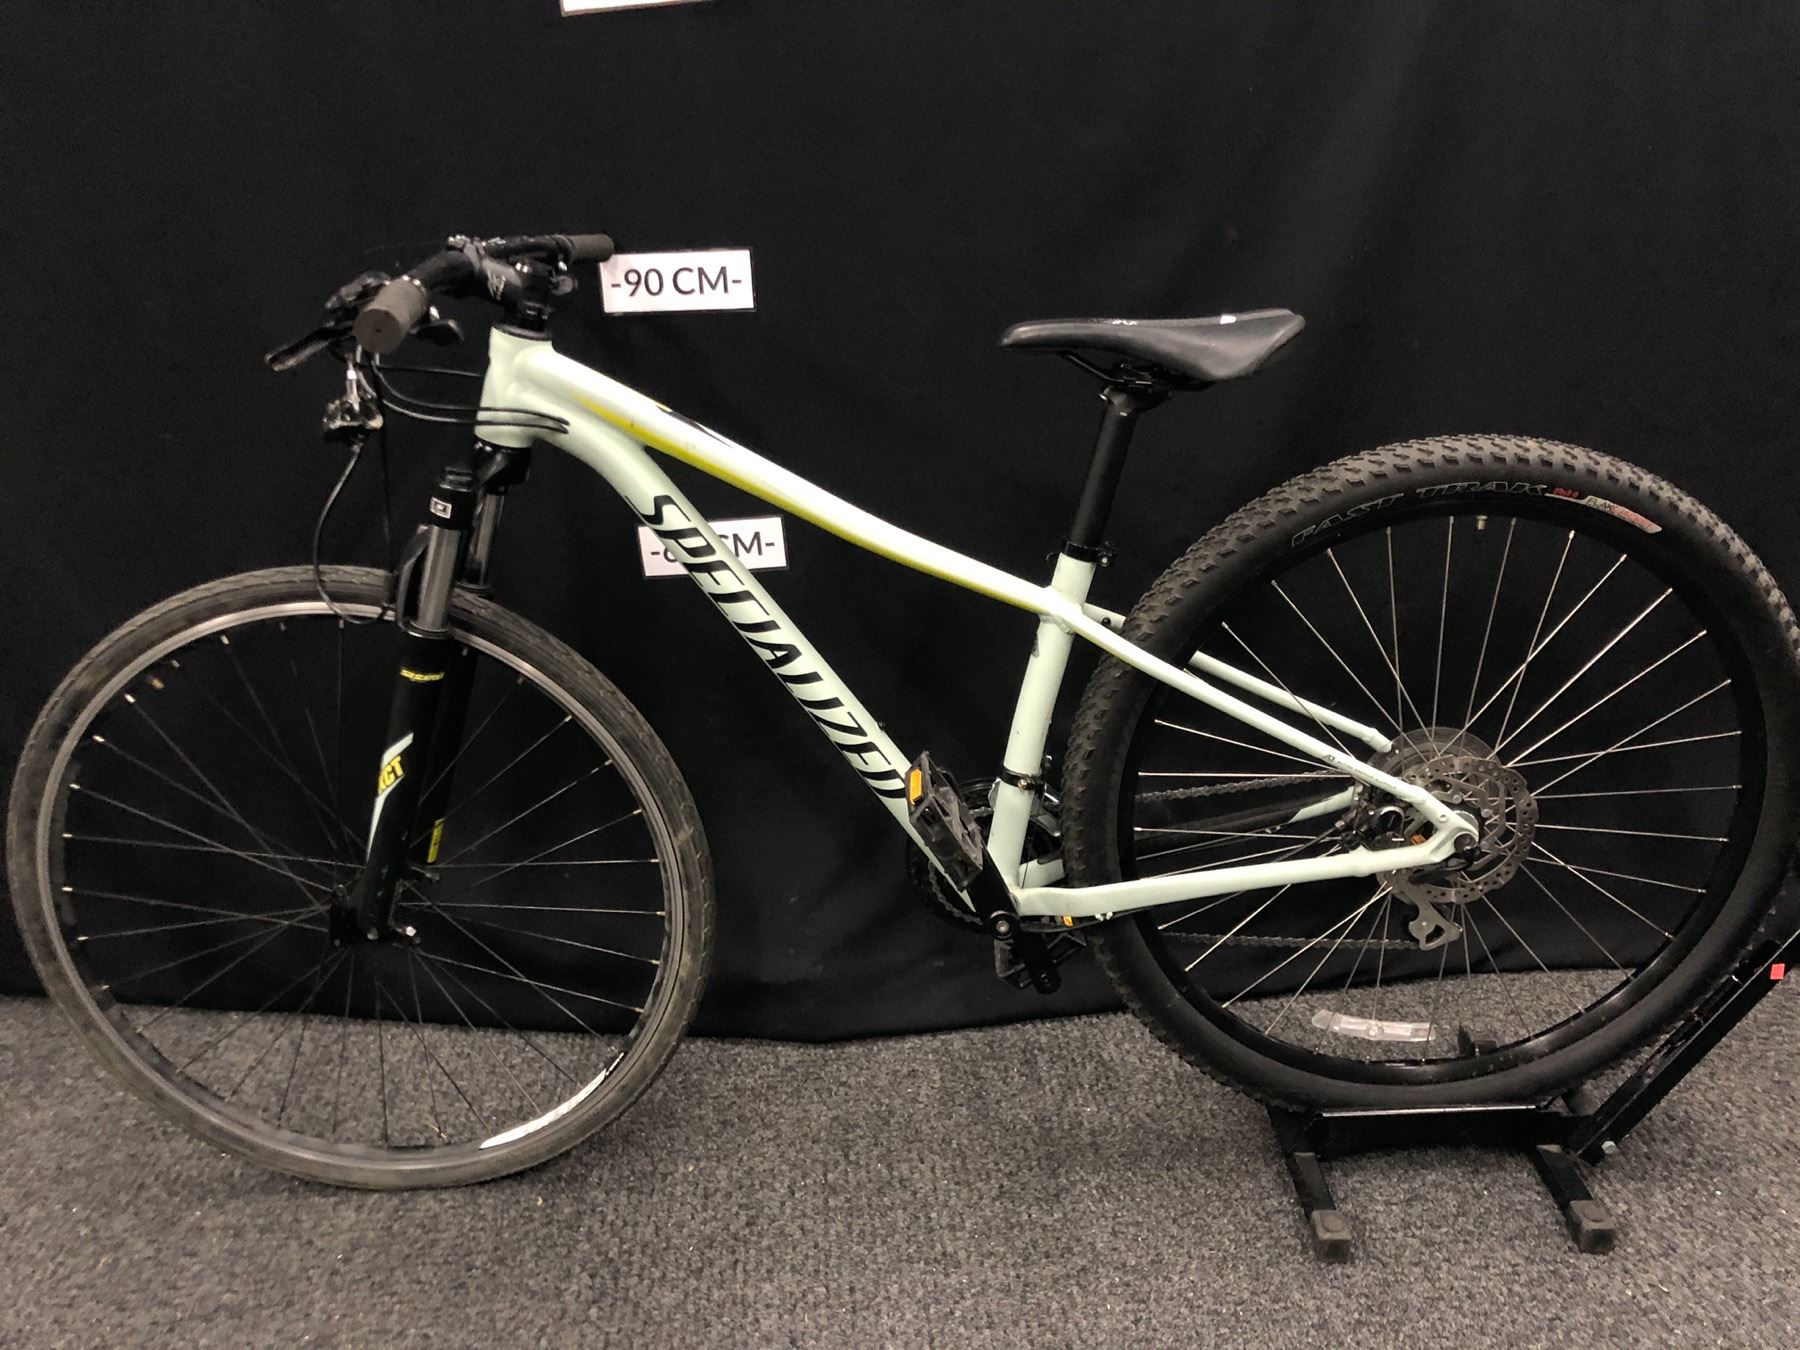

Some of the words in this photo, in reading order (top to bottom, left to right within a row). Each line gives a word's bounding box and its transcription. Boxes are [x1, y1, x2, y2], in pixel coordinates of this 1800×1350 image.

[611, 268, 664, 297] -90
[672, 266, 742, 295] CM-
[1291, 493, 1405, 547] FAST
[718, 531, 775, 558] M-
[625, 494, 907, 799] SPECIALIZED
